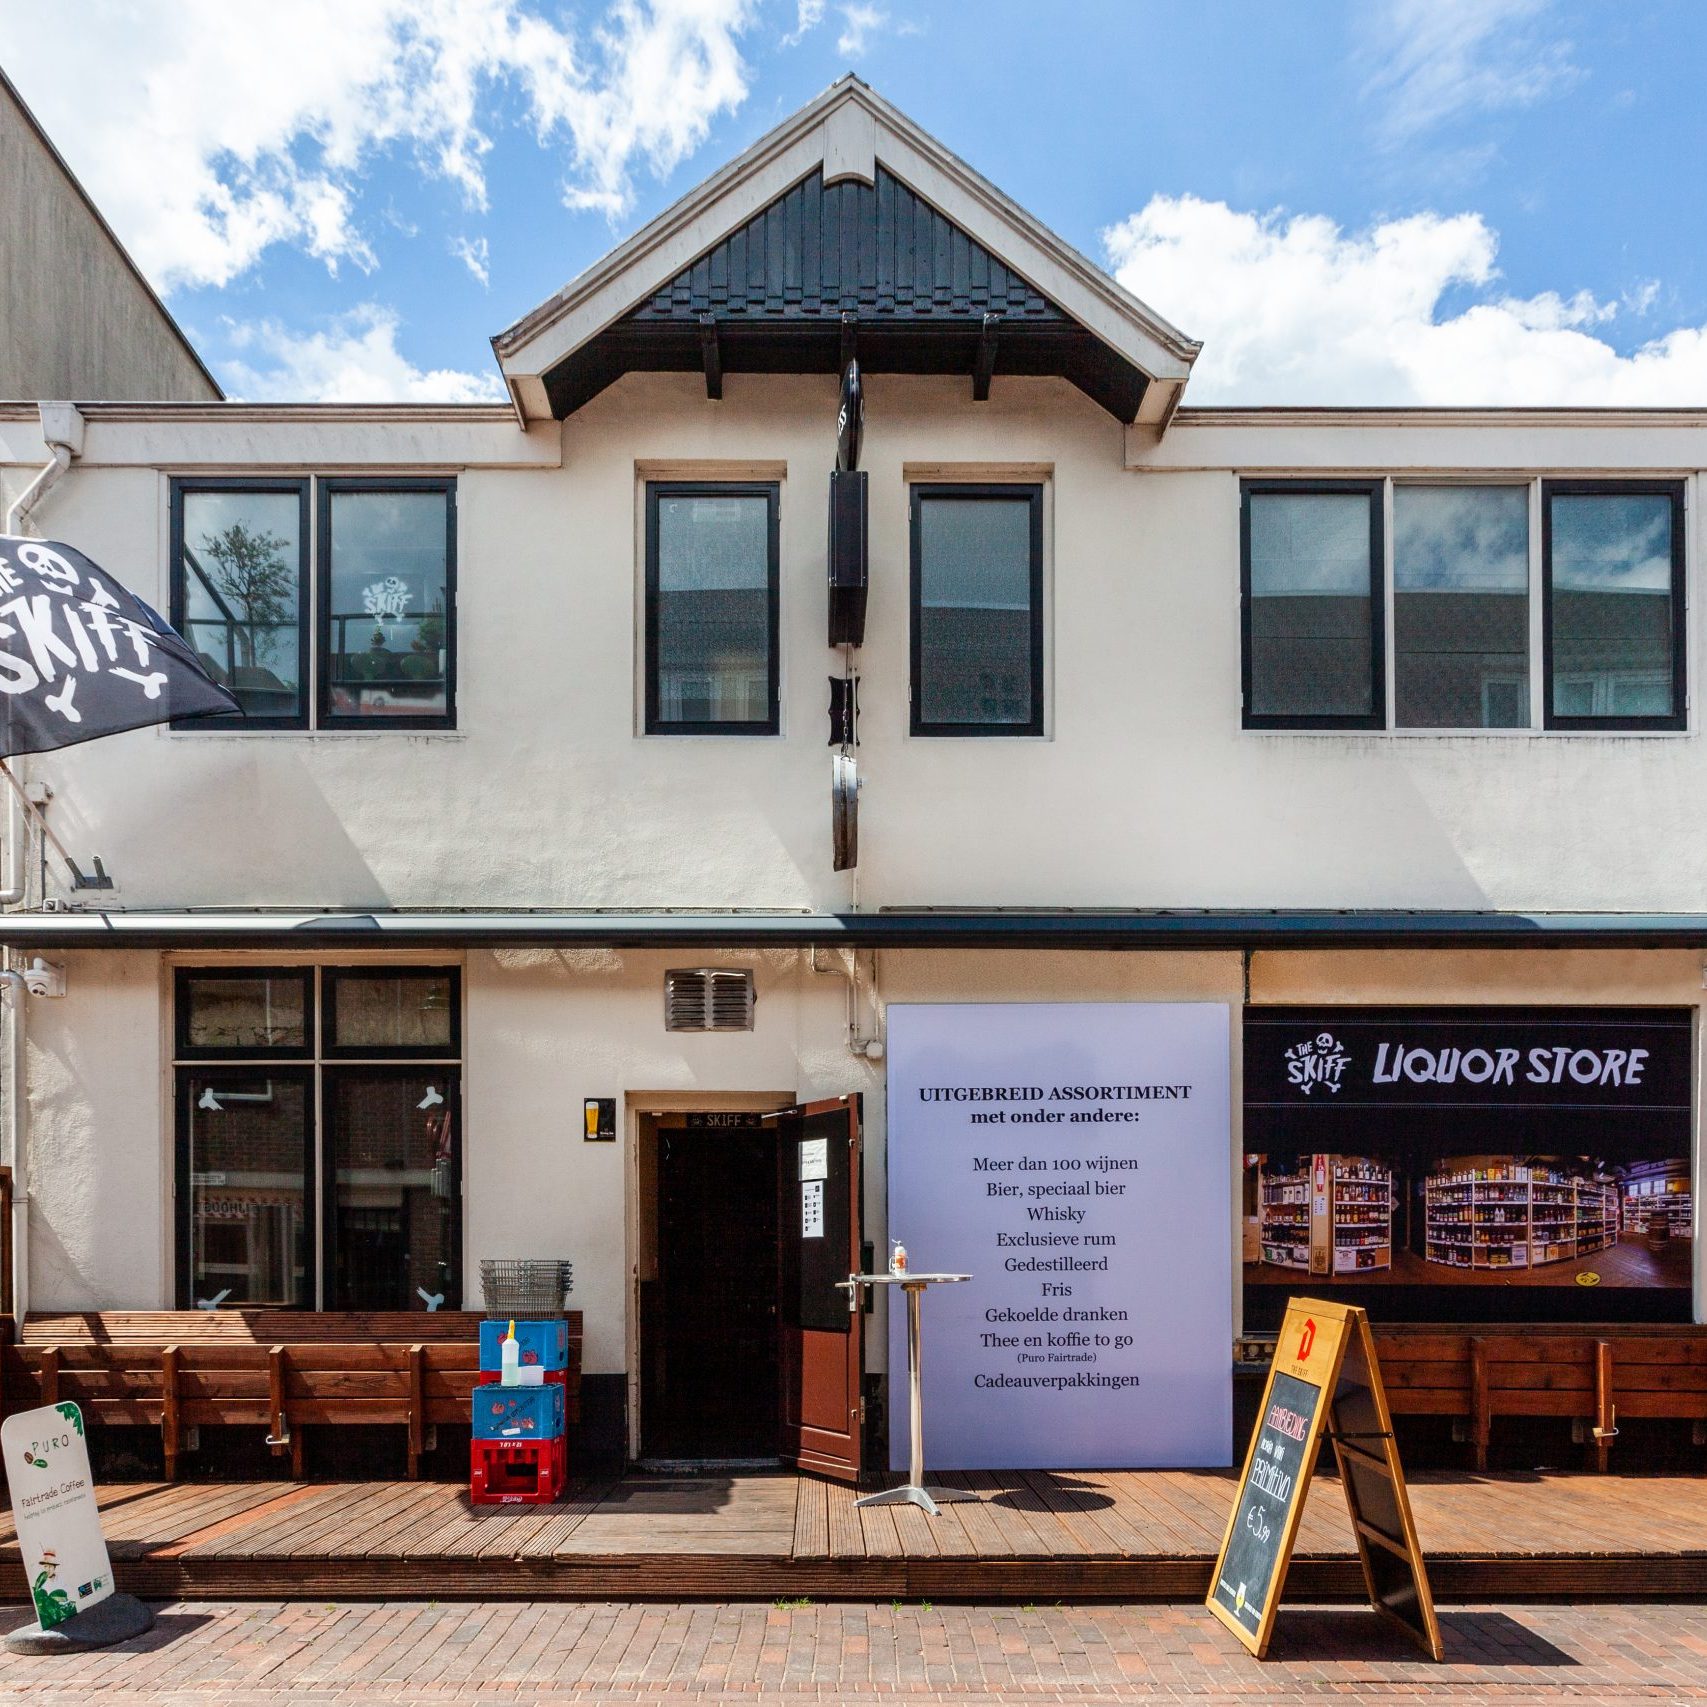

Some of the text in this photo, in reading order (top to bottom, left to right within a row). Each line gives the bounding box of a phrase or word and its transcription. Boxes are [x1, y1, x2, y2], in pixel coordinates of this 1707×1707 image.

[0, 594, 162, 695] SKIFF
[1296, 1041, 1313, 1056] THE
[1287, 1054, 1352, 1084] SKIFF
[1372, 1043, 1649, 1087] LIQUOR STORE
[919, 1085, 1192, 1102] UITGEBREID ASSORTIMENT
[706, 1114, 742, 1127] SKIFF
[970, 1107, 1140, 1124] met onder andere:
[973, 1155, 1139, 1173] Meer dan 100 wijnen
[986, 1181, 1127, 1199] Bier, speciaal bier
[1026, 1206, 1087, 1224] Whisky
[996, 1231, 1117, 1247] Exclusieve rum
[1004, 1256, 1109, 1272] Gedestilleerd
[1041, 1281, 1073, 1297] Fris
[985, 1306, 1129, 1322] Gekoelde dranken
[980, 1331, 1134, 1350] Thee en koffie to go
[1017, 1352, 1098, 1364] (Puro Fairtrade)
[973, 1371, 1141, 1391] Cadeauverpakkingen
[32, 1434, 69, 1456] PURO
[21, 1479, 85, 1508] Fairtrade Coffee
